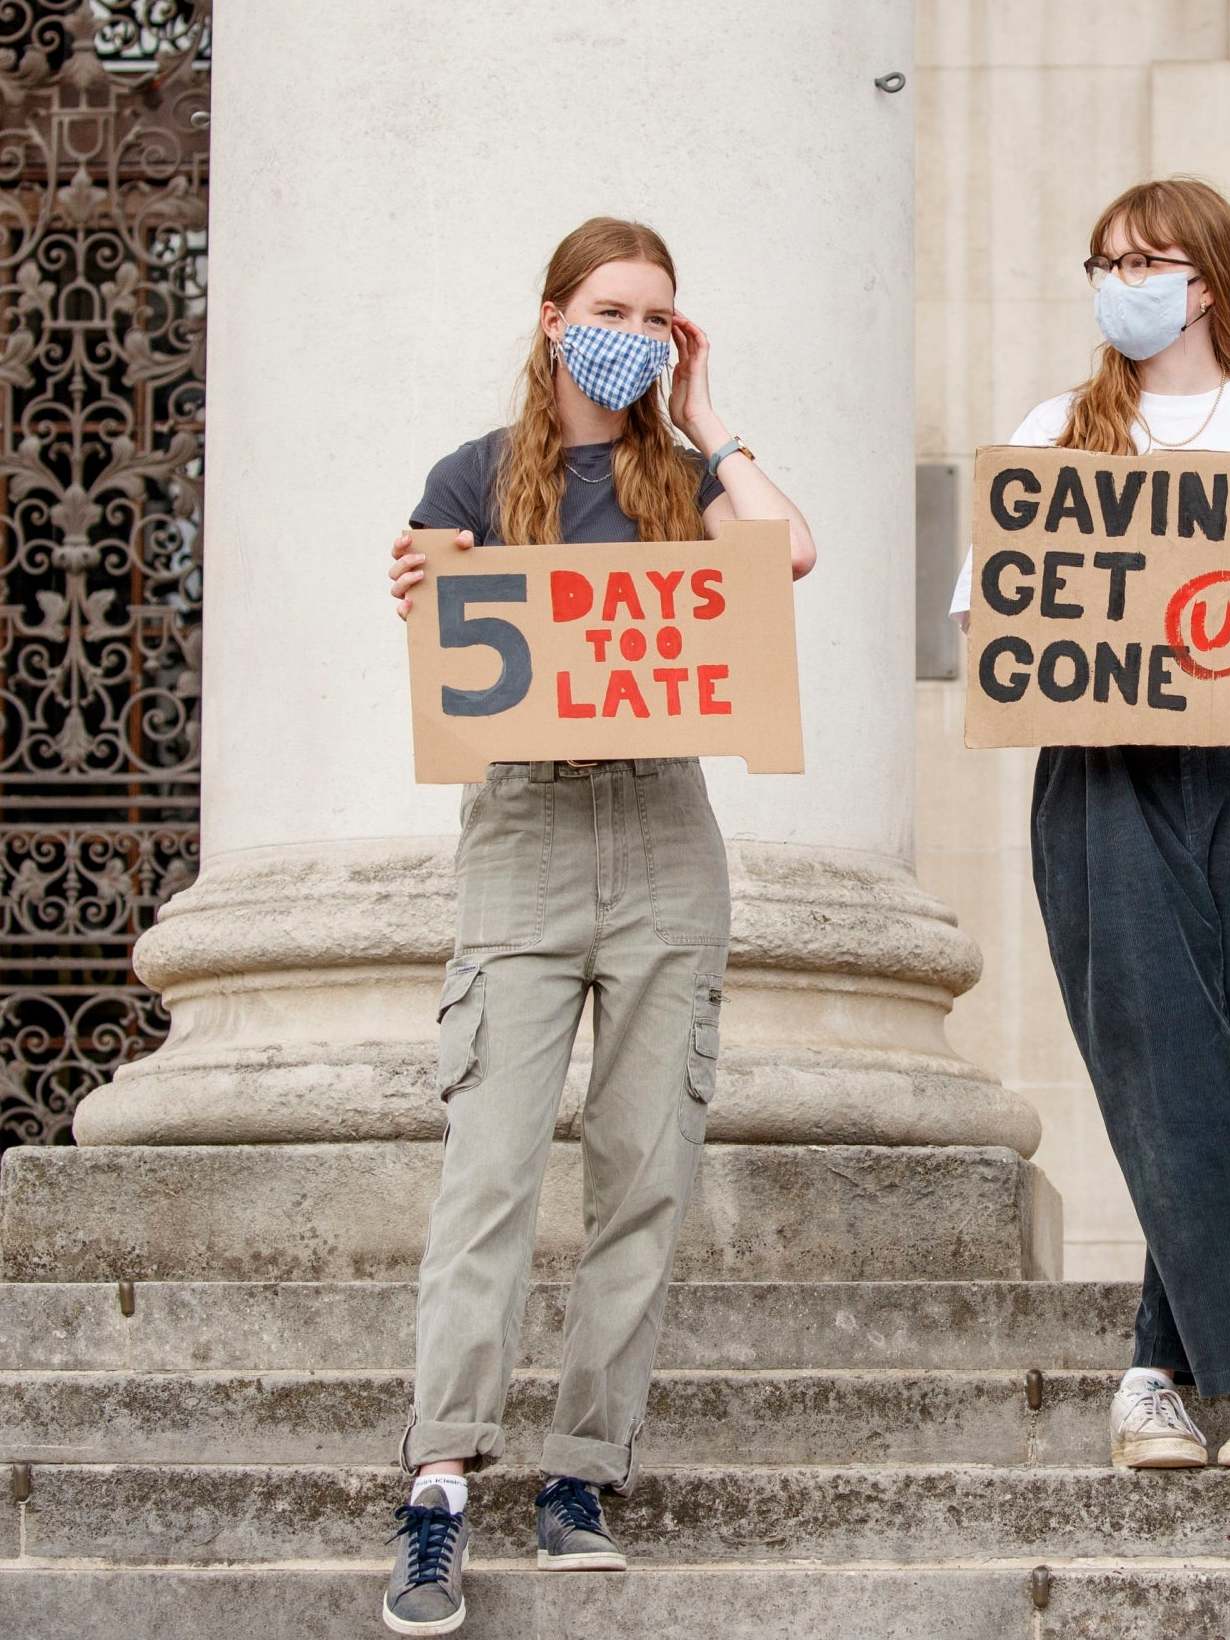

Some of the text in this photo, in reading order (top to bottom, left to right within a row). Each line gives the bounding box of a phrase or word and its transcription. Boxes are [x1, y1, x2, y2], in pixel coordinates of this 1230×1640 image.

[990, 466, 1229, 541] GAVIN
[981, 550, 1146, 621] GET
[437, 569, 726, 717] 5 DAYS
[585, 625, 683, 662] TOO
[979, 635, 1190, 712] GONE
[556, 664, 732, 718] LATE
